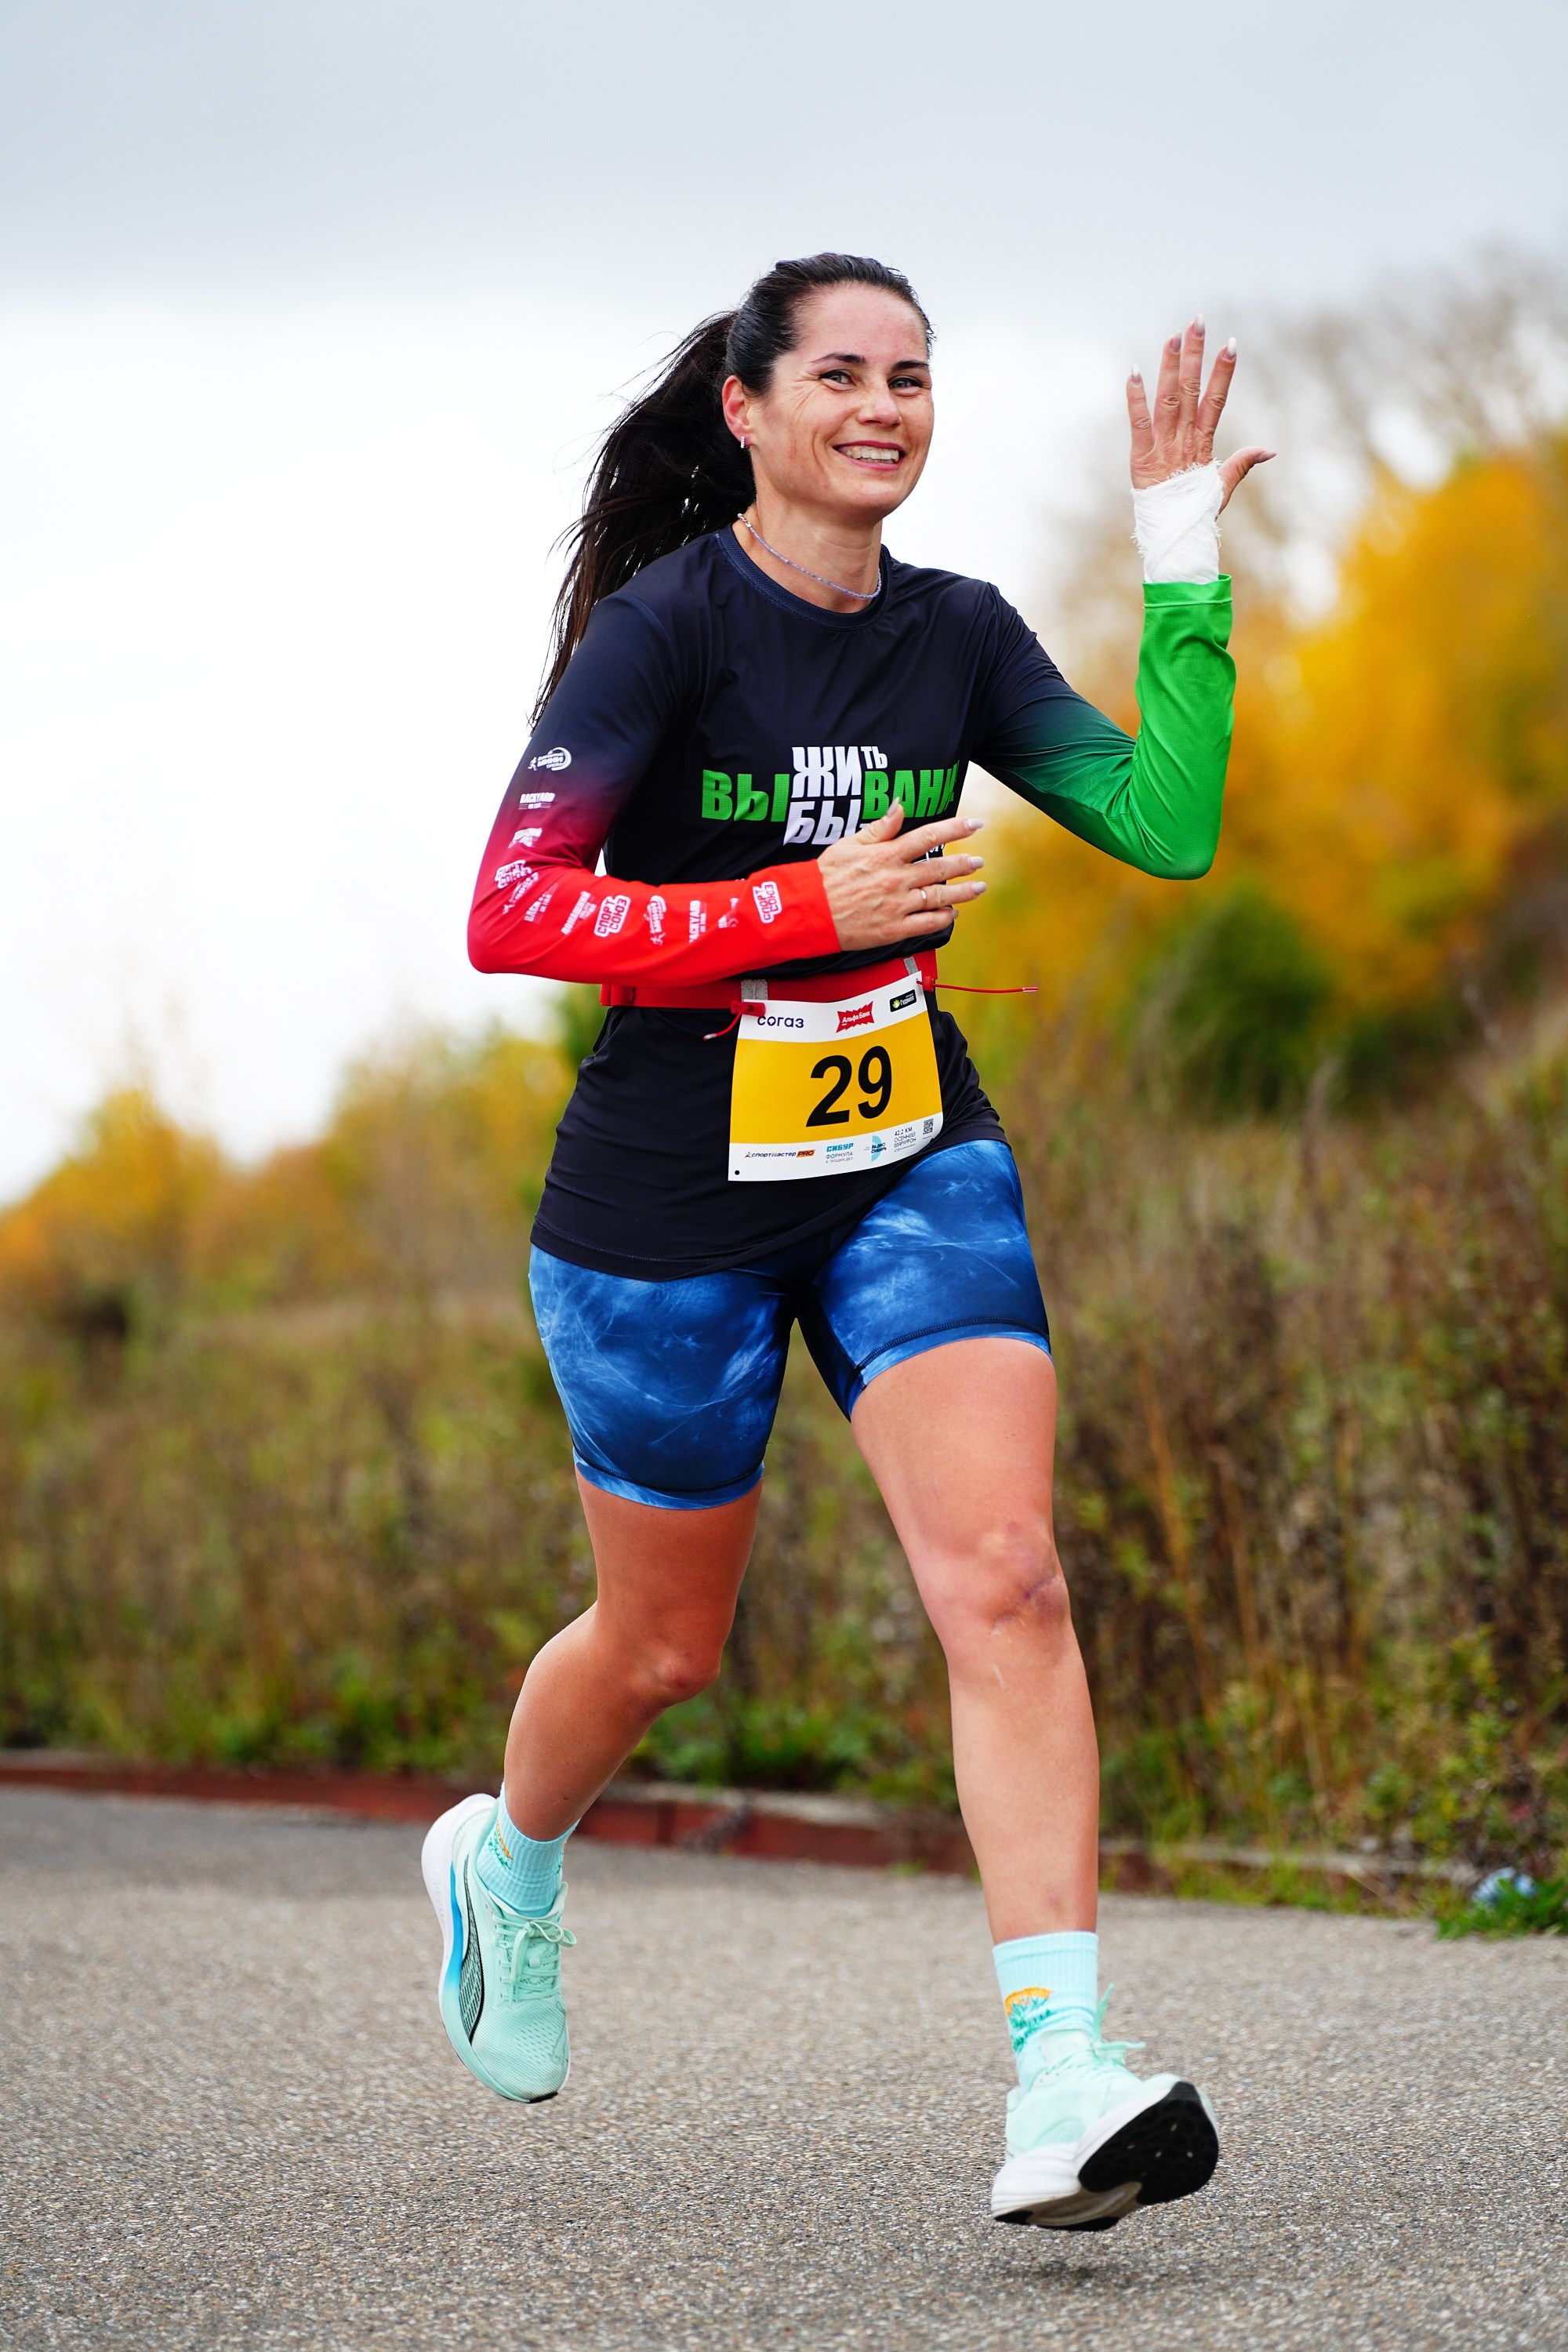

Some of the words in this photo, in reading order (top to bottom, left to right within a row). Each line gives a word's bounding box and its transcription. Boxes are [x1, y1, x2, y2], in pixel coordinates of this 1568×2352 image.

[862, 760, 960, 820] ВАНИ
[782, 799, 871, 846] БЫ
[755, 889, 771, 920] СПОРТ
[764, 884, 779, 913] СОЮЗ
[597, 898, 615, 934] СПОРТ
[609, 898, 627, 931] СОЮЗ
[757, 1015, 804, 1028] согаз
[805, 1045, 892, 1127] 29
[797, 1149, 815, 1158] PRO
[826, 1142, 854, 1152] СИБУР
[826, 1151, 853, 1160] ФОРМУЛА
